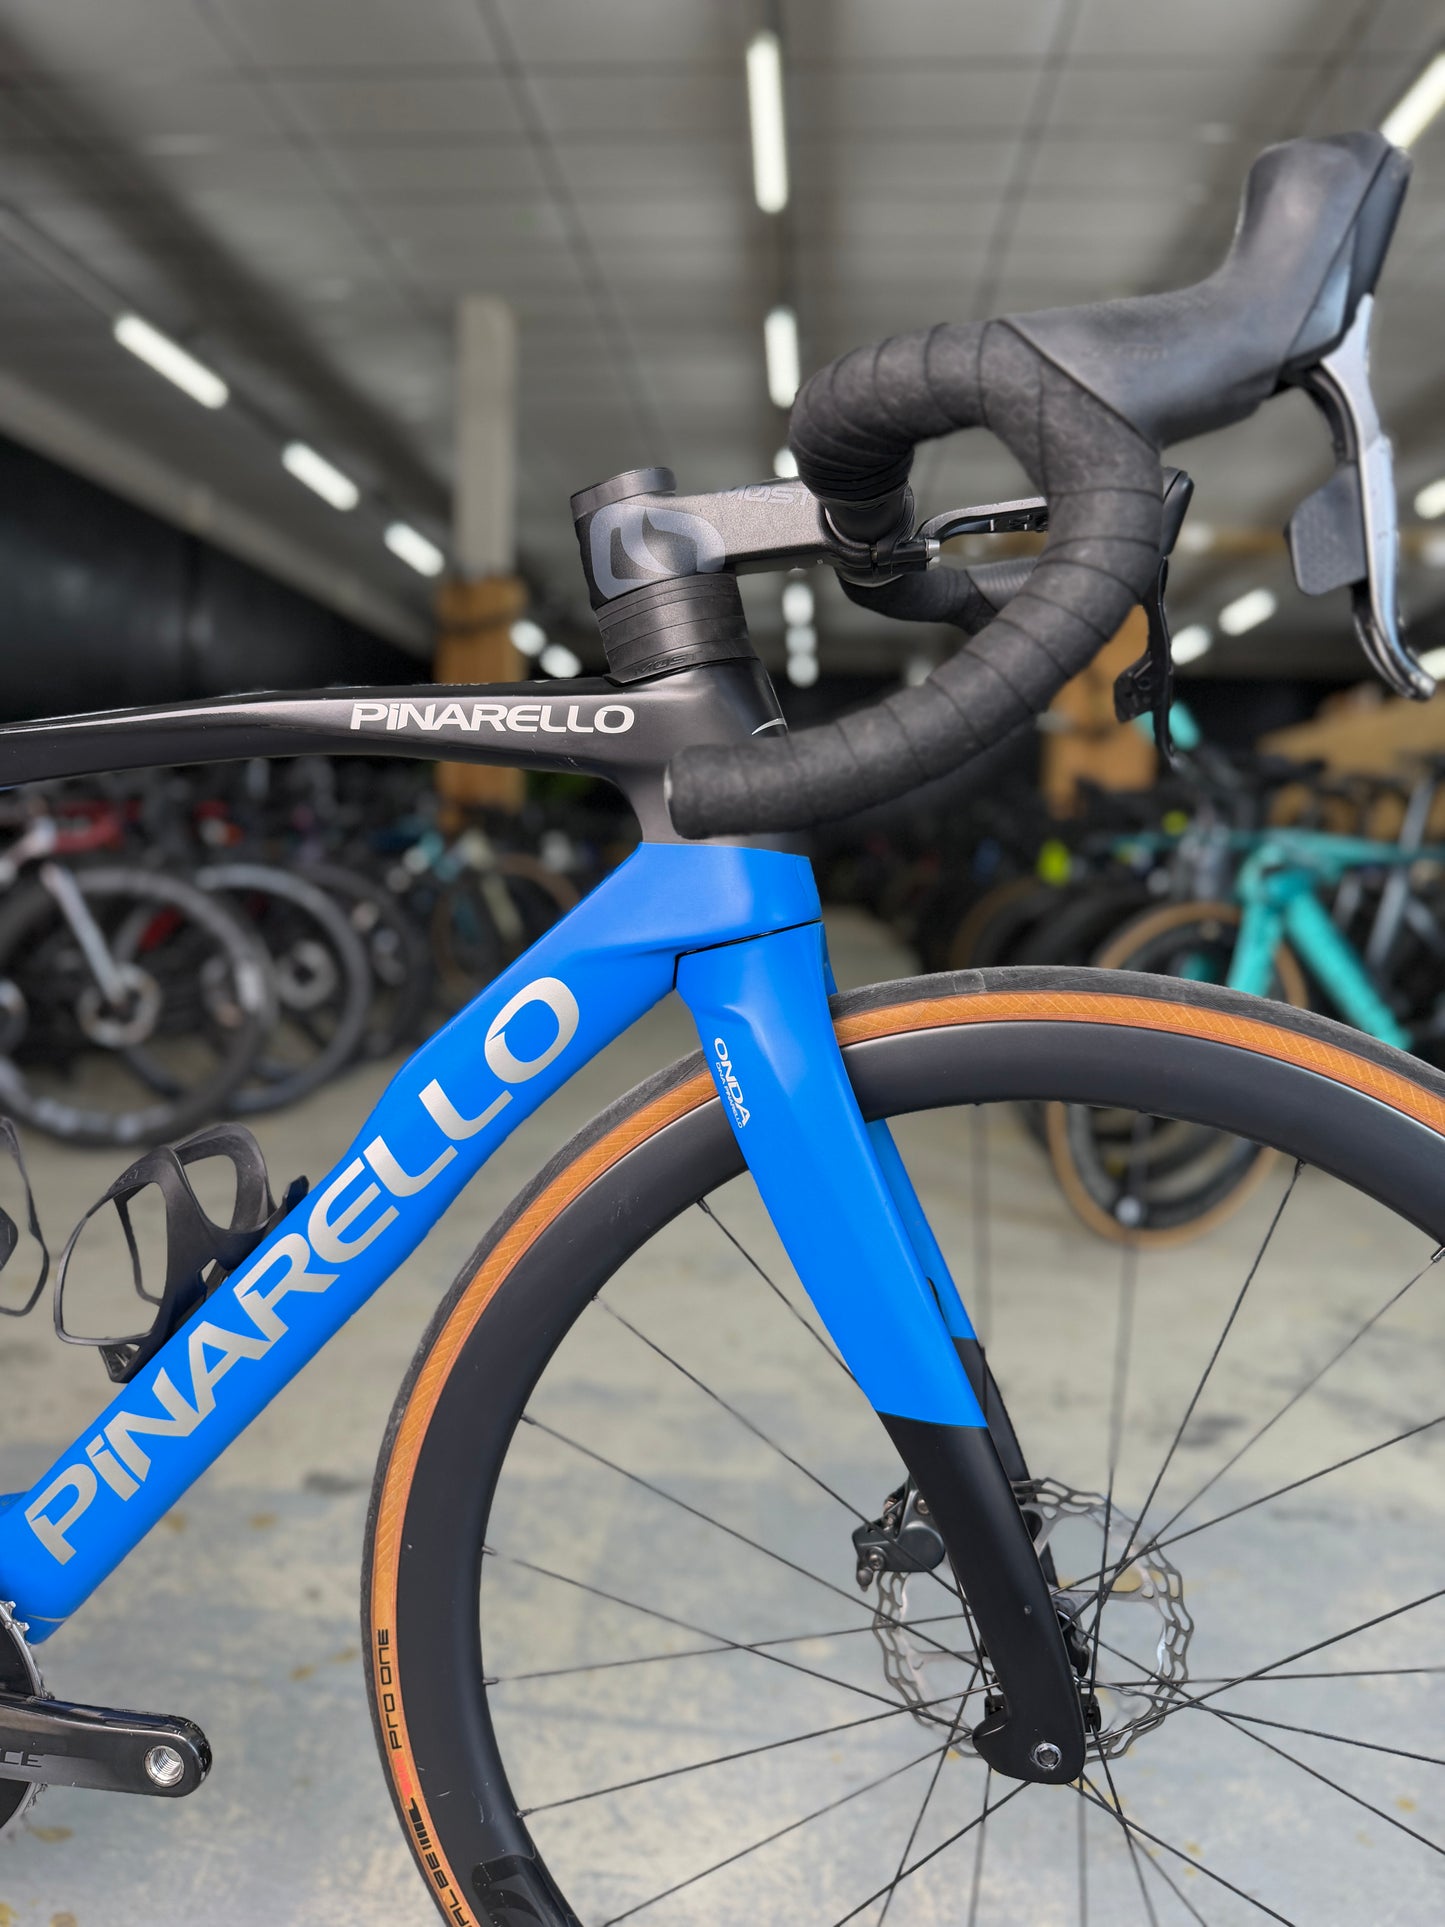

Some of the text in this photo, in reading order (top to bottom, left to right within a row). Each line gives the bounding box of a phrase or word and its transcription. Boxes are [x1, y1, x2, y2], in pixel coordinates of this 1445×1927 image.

[714, 1037, 751, 1127] ONDA
[716, 1062, 726, 1085] DNA
[425, 1851, 472, 1927] ALBE
